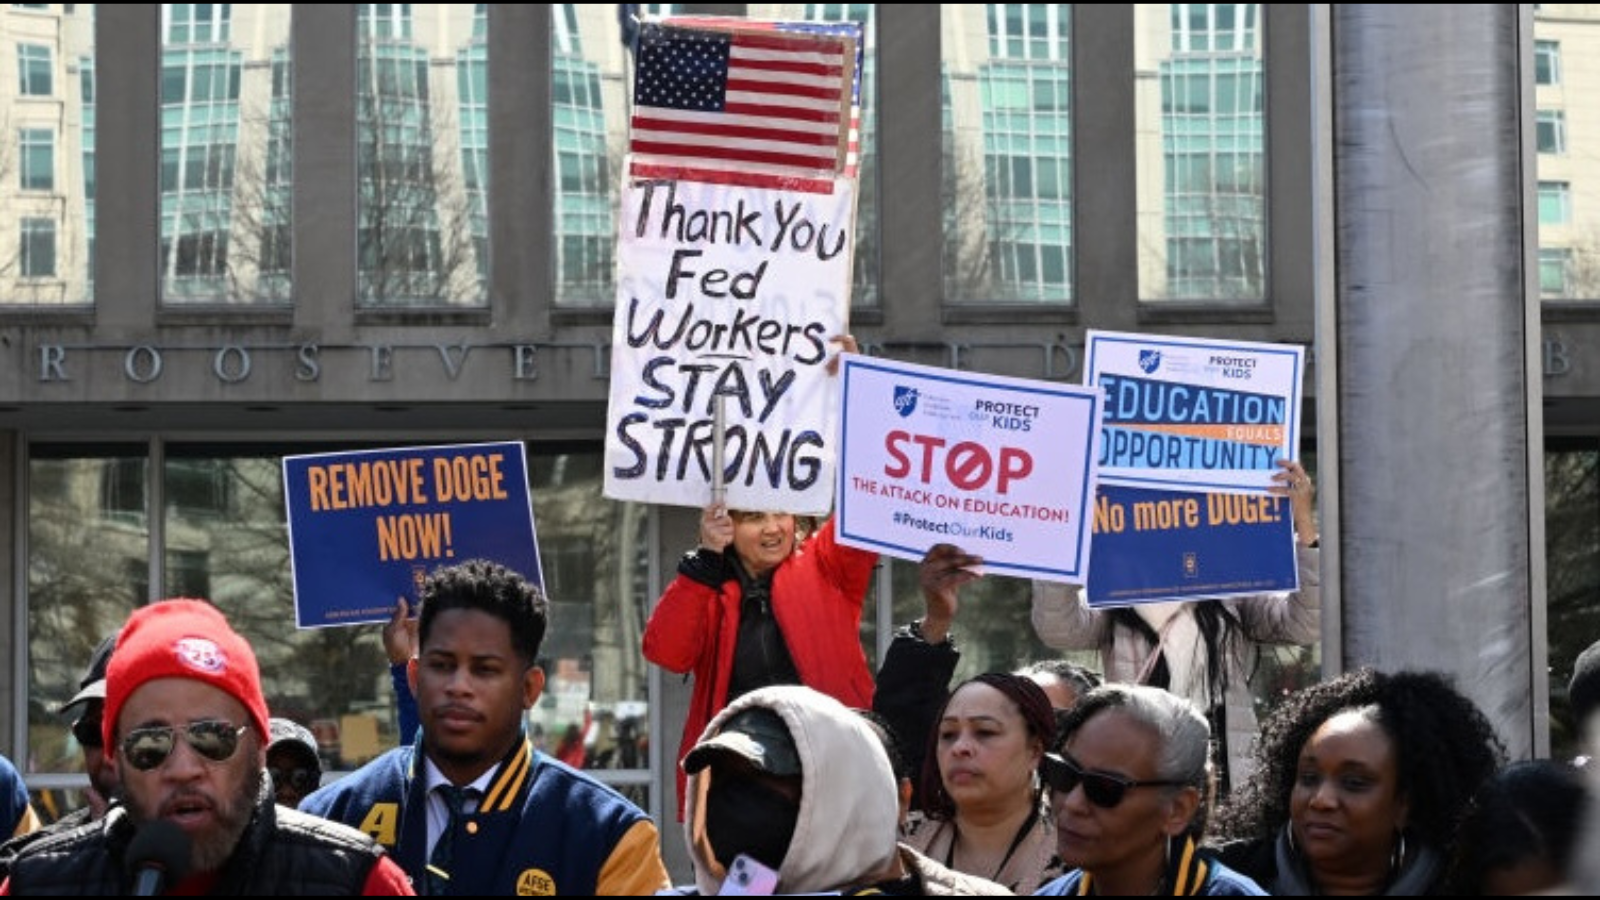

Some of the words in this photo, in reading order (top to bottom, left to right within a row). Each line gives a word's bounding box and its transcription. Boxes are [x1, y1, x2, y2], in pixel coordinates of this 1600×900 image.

[632, 179, 763, 246] Thank
[770, 198, 846, 261] You
[666, 249, 768, 299] Fed
[627, 298, 826, 365] Workers
[1209, 355, 1257, 368] PROTECT
[1222, 368, 1252, 379] KIDS
[634, 356, 796, 423] STAY
[975, 399, 1040, 418] PROTECT
[1098, 377, 1285, 424] EDUCATION
[992, 415, 1032, 432] KIDS
[1227, 425, 1282, 440] EQUALS
[613, 411, 824, 491] STRONG
[884, 430, 1033, 495] STOP
[308, 458, 428, 511] REMOVE
[433, 454, 508, 502] DOGE
[853, 477, 877, 495] THE
[880, 483, 931, 505] ATTACK
[935, 494, 959, 509] ON
[963, 499, 1069, 523] EDUCATION!
[893, 511, 1014, 542] #ProtectOurKids
[1092, 496, 1125, 534] No
[1133, 498, 1199, 532] more
[1207, 493, 1282, 526] DOGE!
[376, 513, 454, 562] NOW!
[358, 803, 399, 845] A
